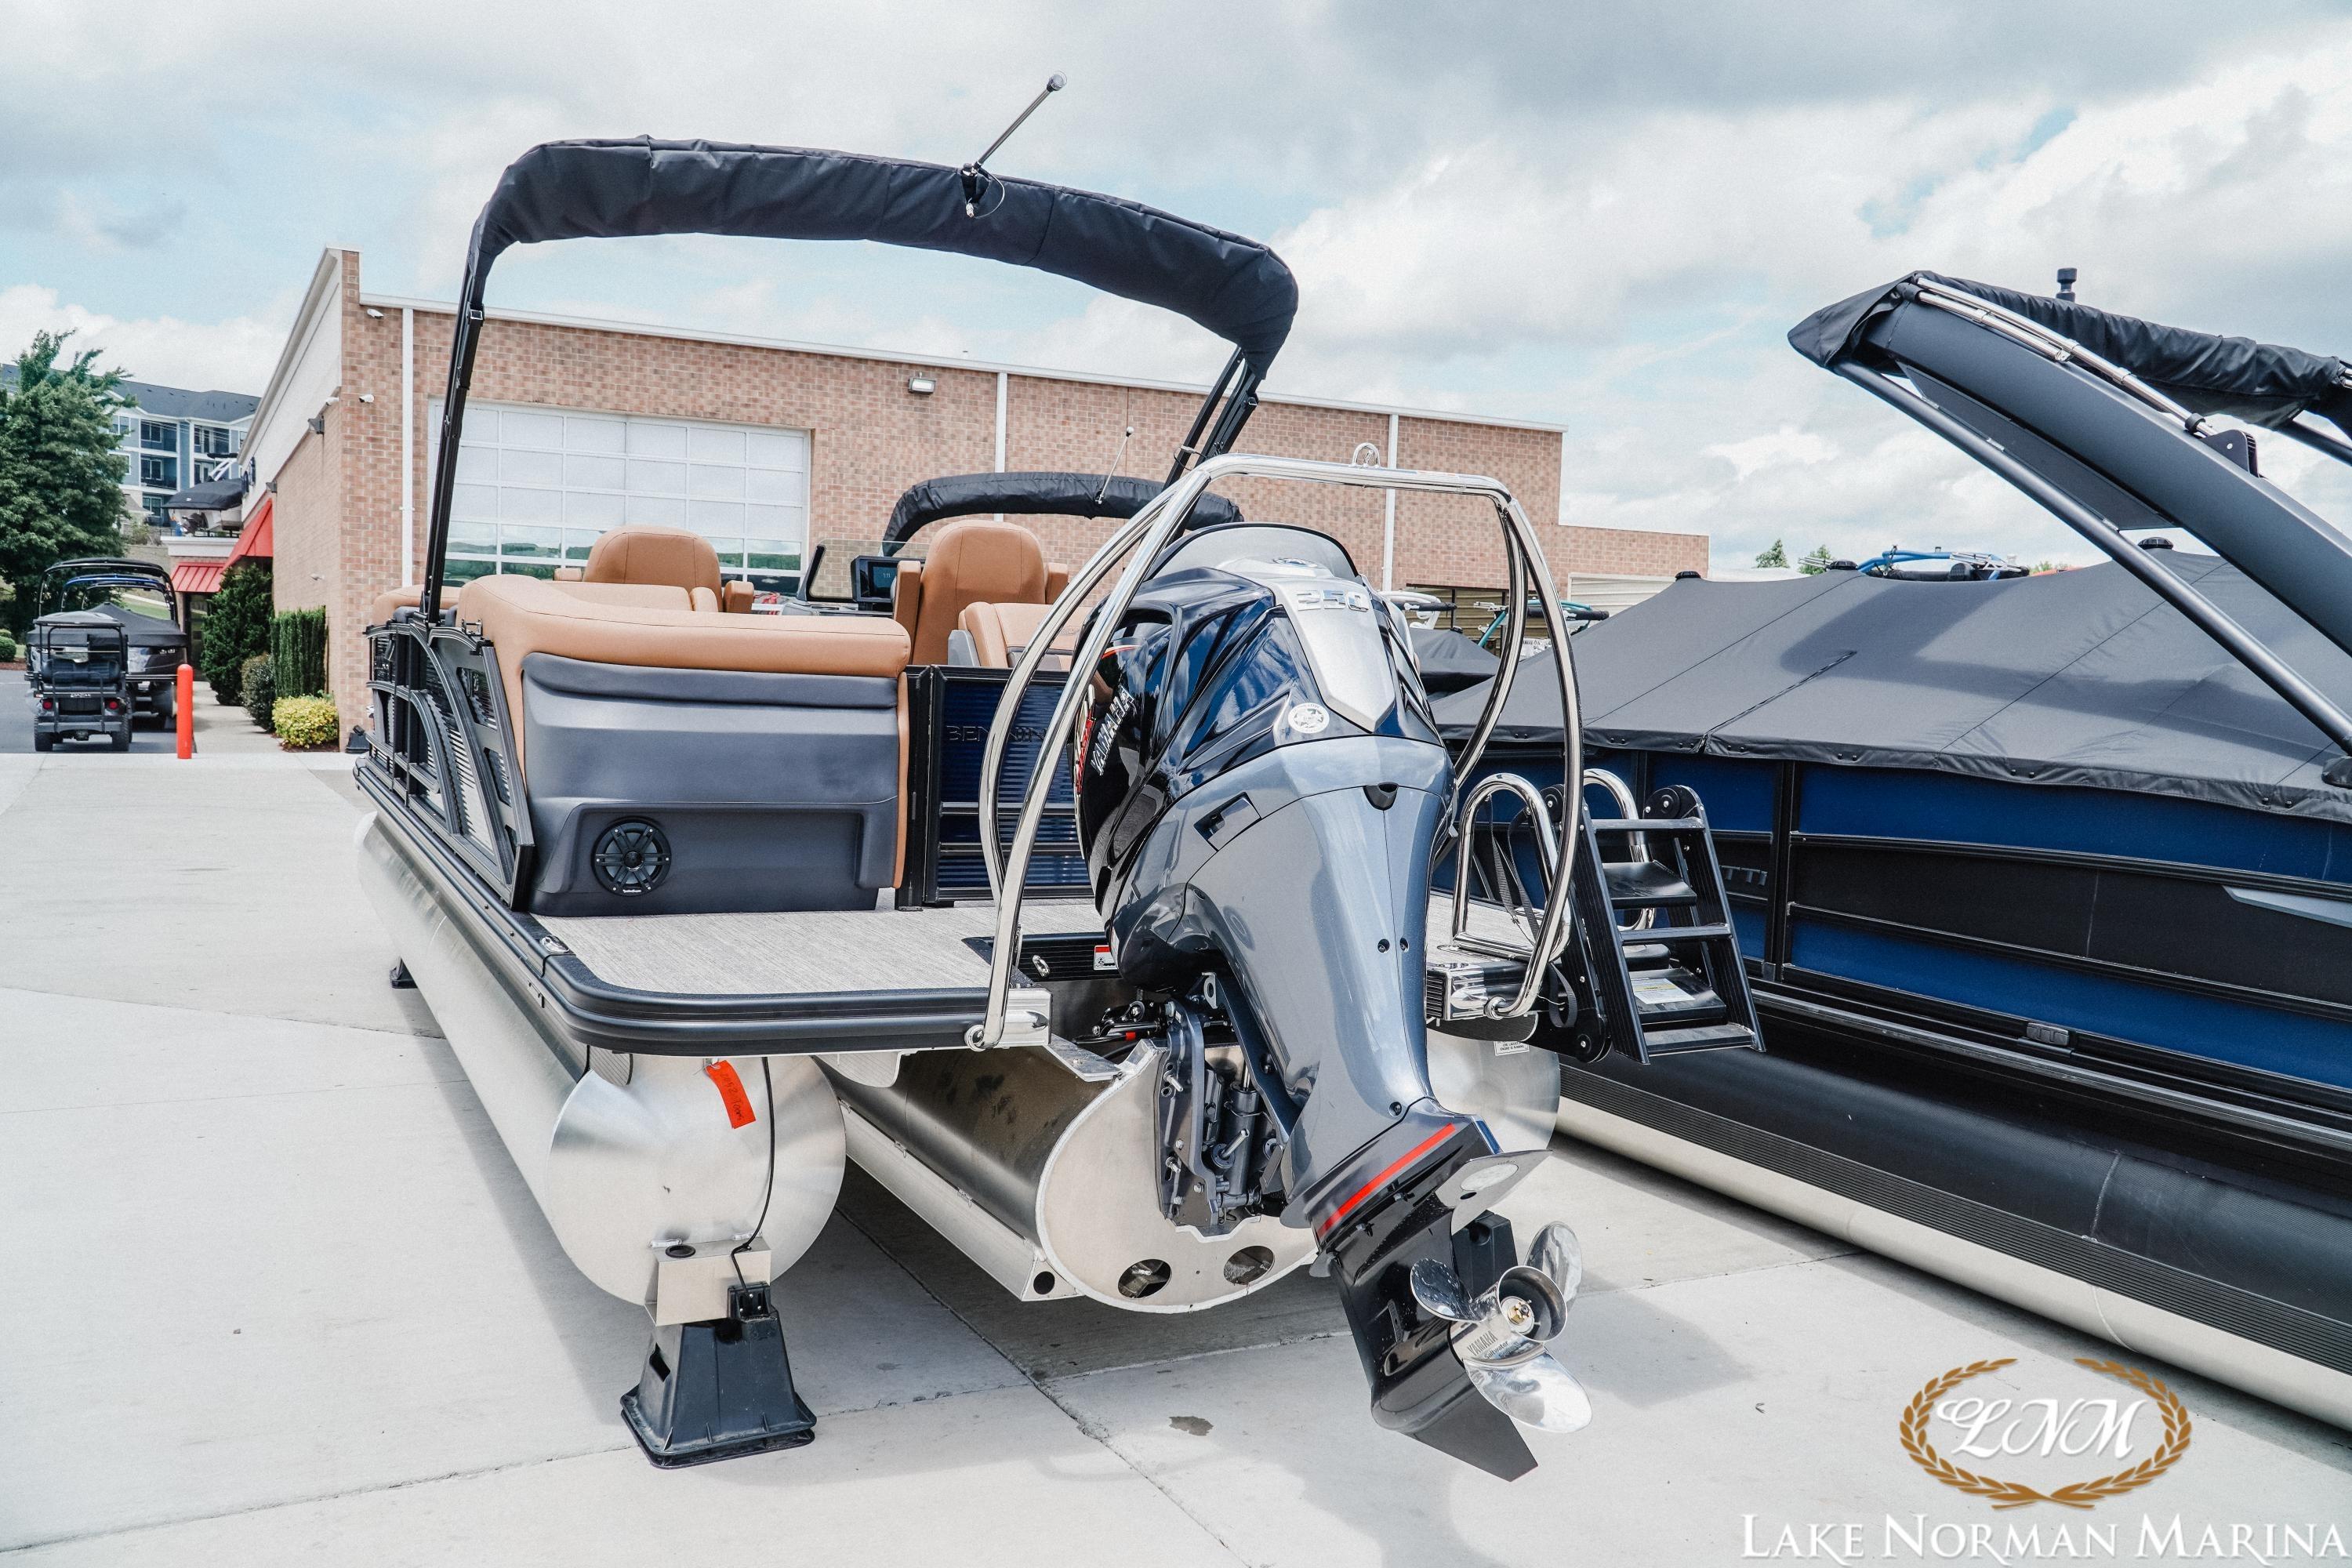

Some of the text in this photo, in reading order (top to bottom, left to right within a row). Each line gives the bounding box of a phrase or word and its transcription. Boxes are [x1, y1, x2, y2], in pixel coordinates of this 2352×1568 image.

[1296, 590, 1369, 612] 250
[1091, 684, 1134, 776] YAMAHA
[1468, 1330, 1498, 1356] YAMAHA
[1484, 1341, 1508, 1359] Saltwater
